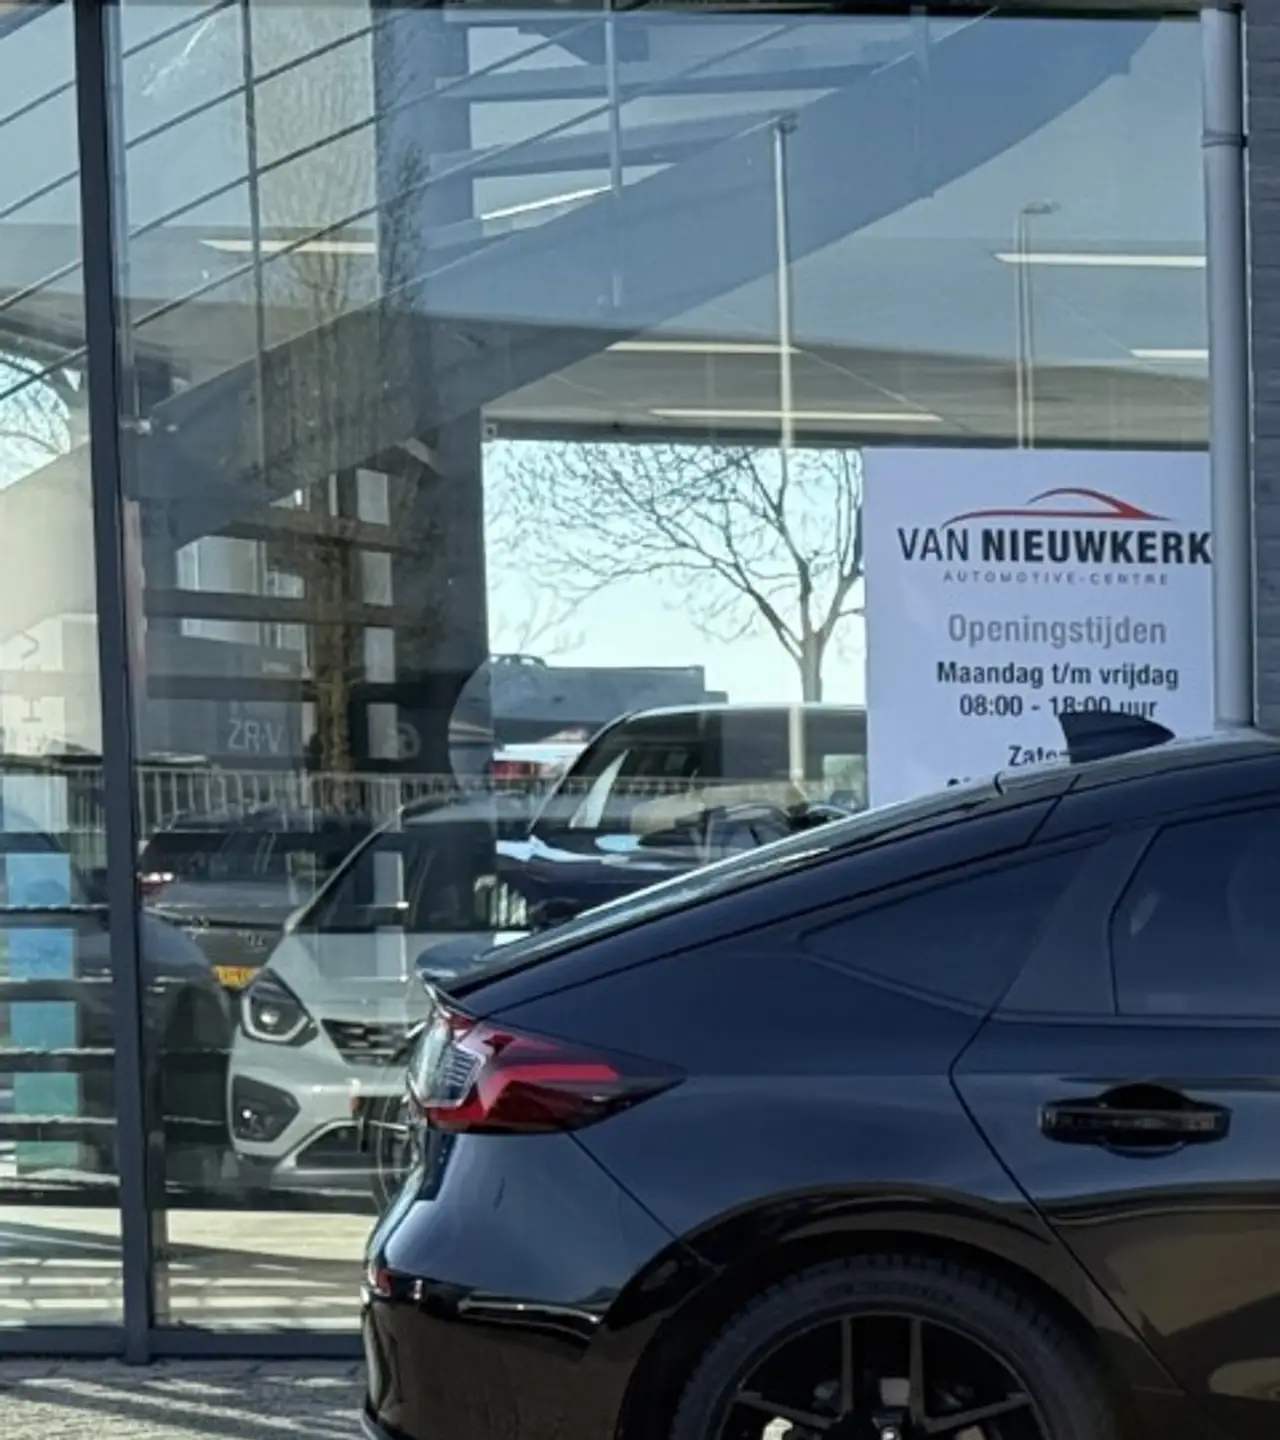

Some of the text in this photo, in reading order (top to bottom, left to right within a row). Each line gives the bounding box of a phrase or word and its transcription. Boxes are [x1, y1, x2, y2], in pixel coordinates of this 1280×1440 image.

[897, 527, 1213, 565] VAN NIEUWKERK
[947, 613, 1168, 649] Openingstijden
[936, 661, 1180, 690] Maandag t/m vrijdag
[959, 693, 1024, 717] 08:00
[1049, 695, 1112, 717] 18:00
